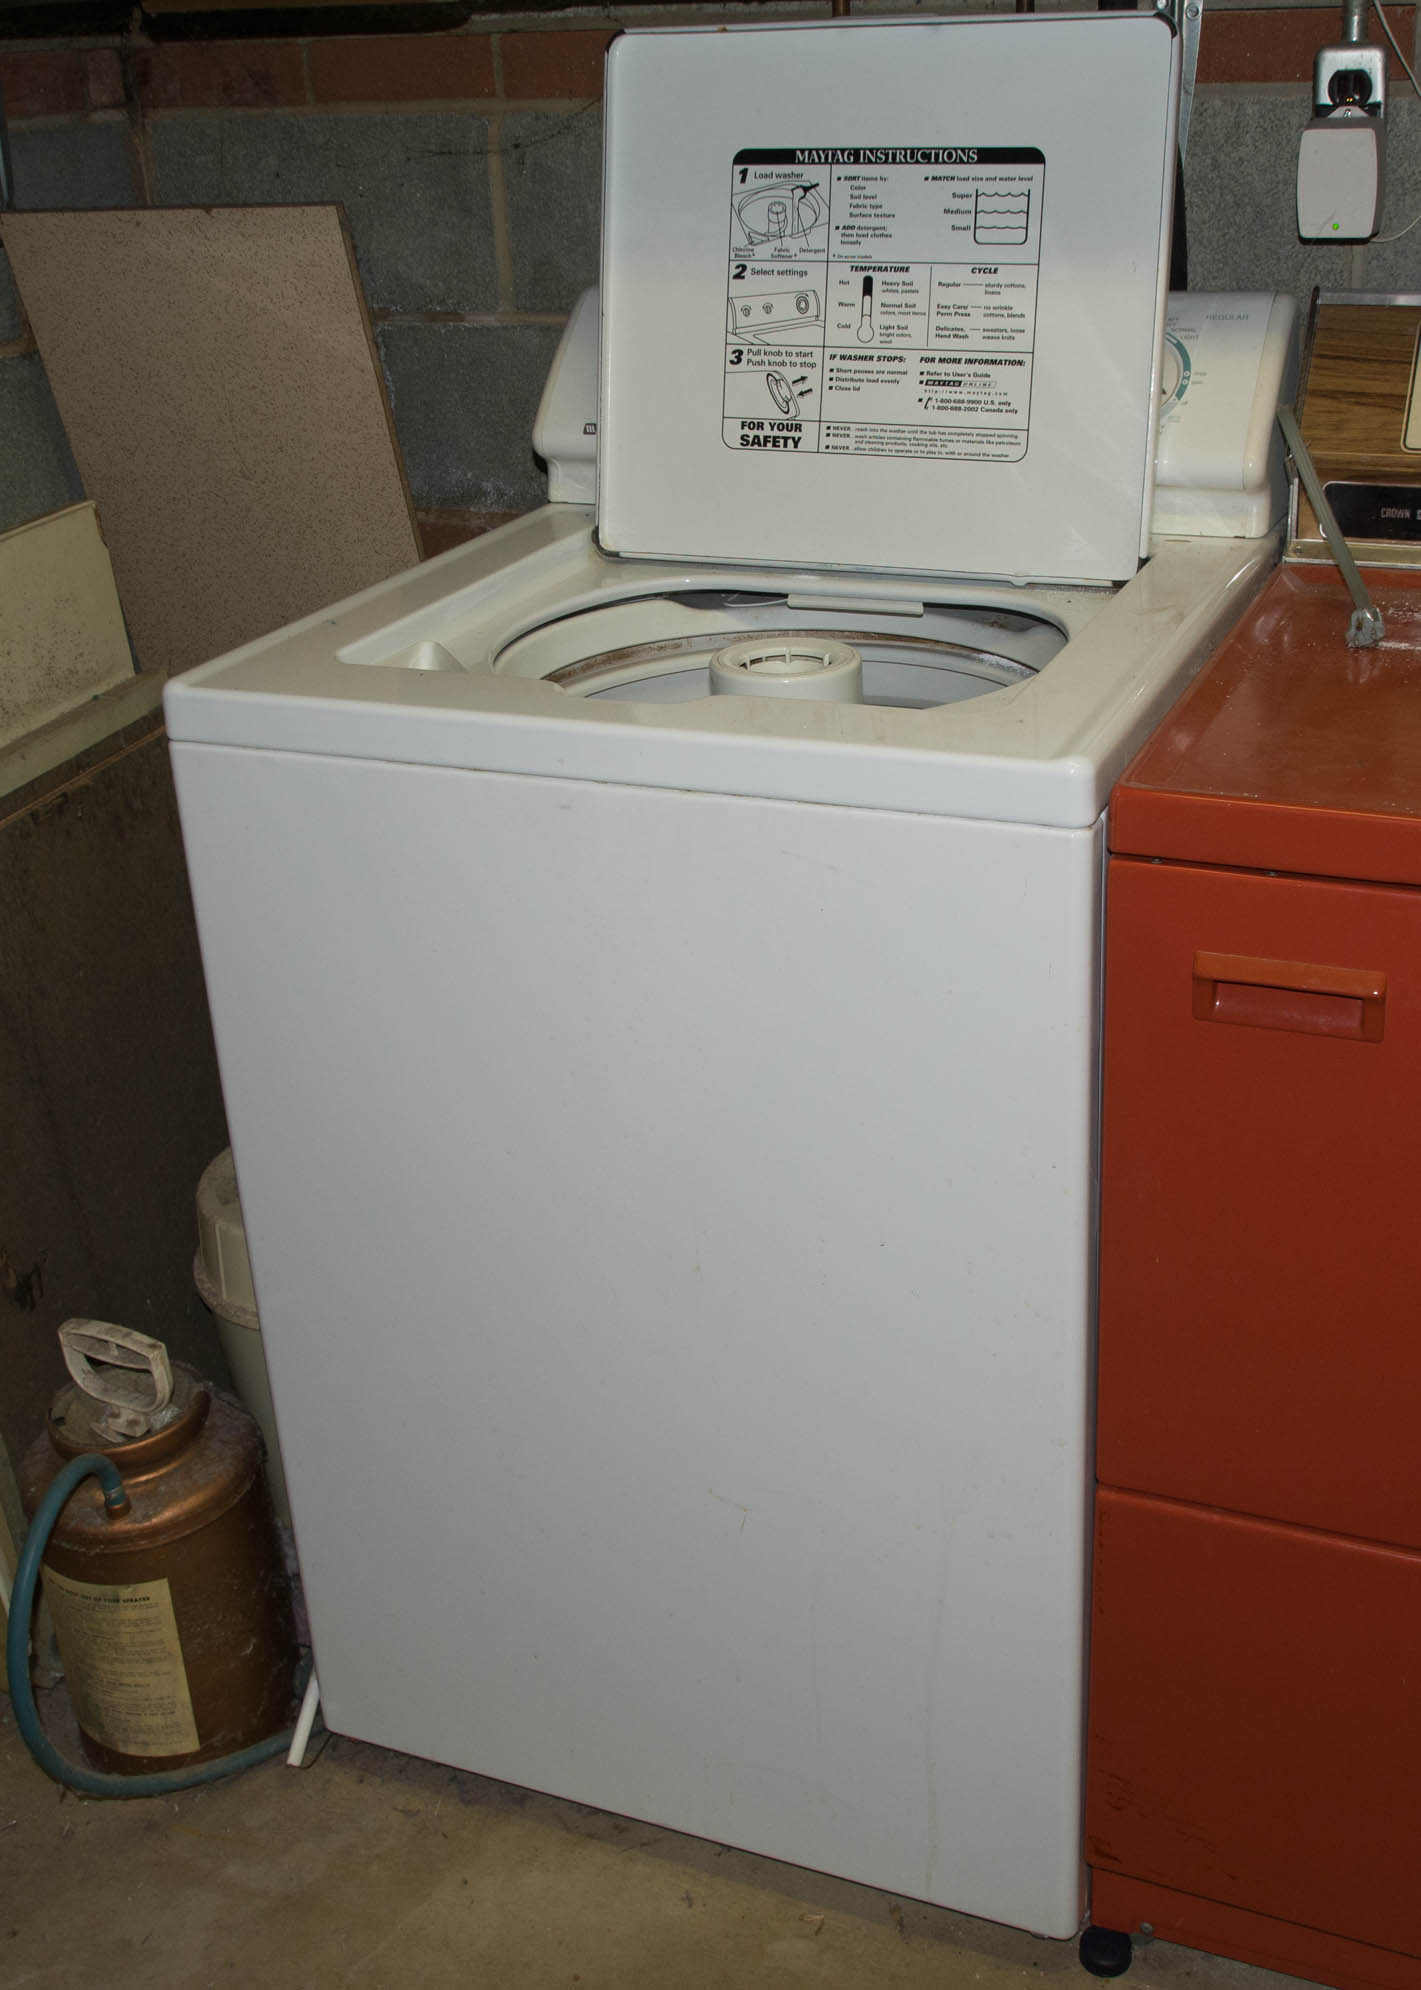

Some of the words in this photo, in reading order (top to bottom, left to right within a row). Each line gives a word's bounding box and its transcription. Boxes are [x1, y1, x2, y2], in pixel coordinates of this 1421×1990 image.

[795, 150, 854, 163] MAYTAG
[860, 149, 978, 163] INSTRUCTIONS
[739, 168, 749, 184] 1
[754, 171, 773, 179] Load
[775, 171, 803, 179] washer
[952, 192, 972, 200] Super
[732, 263, 748, 280] 2
[750, 268, 775, 276] Select
[777, 268, 808, 278] settings
[850, 265, 911, 273] TEMPERATURE
[1206, 313, 1249, 321] REGULAR
[729, 349, 744, 365] 3
[747, 348, 762, 356] Pull
[763, 349, 783, 357] knob
[839, 354, 875, 362] WASHER
[876, 355, 907, 363] STOPS:
[919, 356, 936, 364] FOR
[964, 358, 1026, 366] INFORMATION:
[767, 359, 787, 367] knob
[799, 361, 816, 369] stop
[1005, 407, 1018, 415] only
[741, 421, 764, 431] FOR
[768, 422, 802, 433] YOUR
[740, 434, 802, 449] SAFETY
[1380, 507, 1411, 518] CROWN
